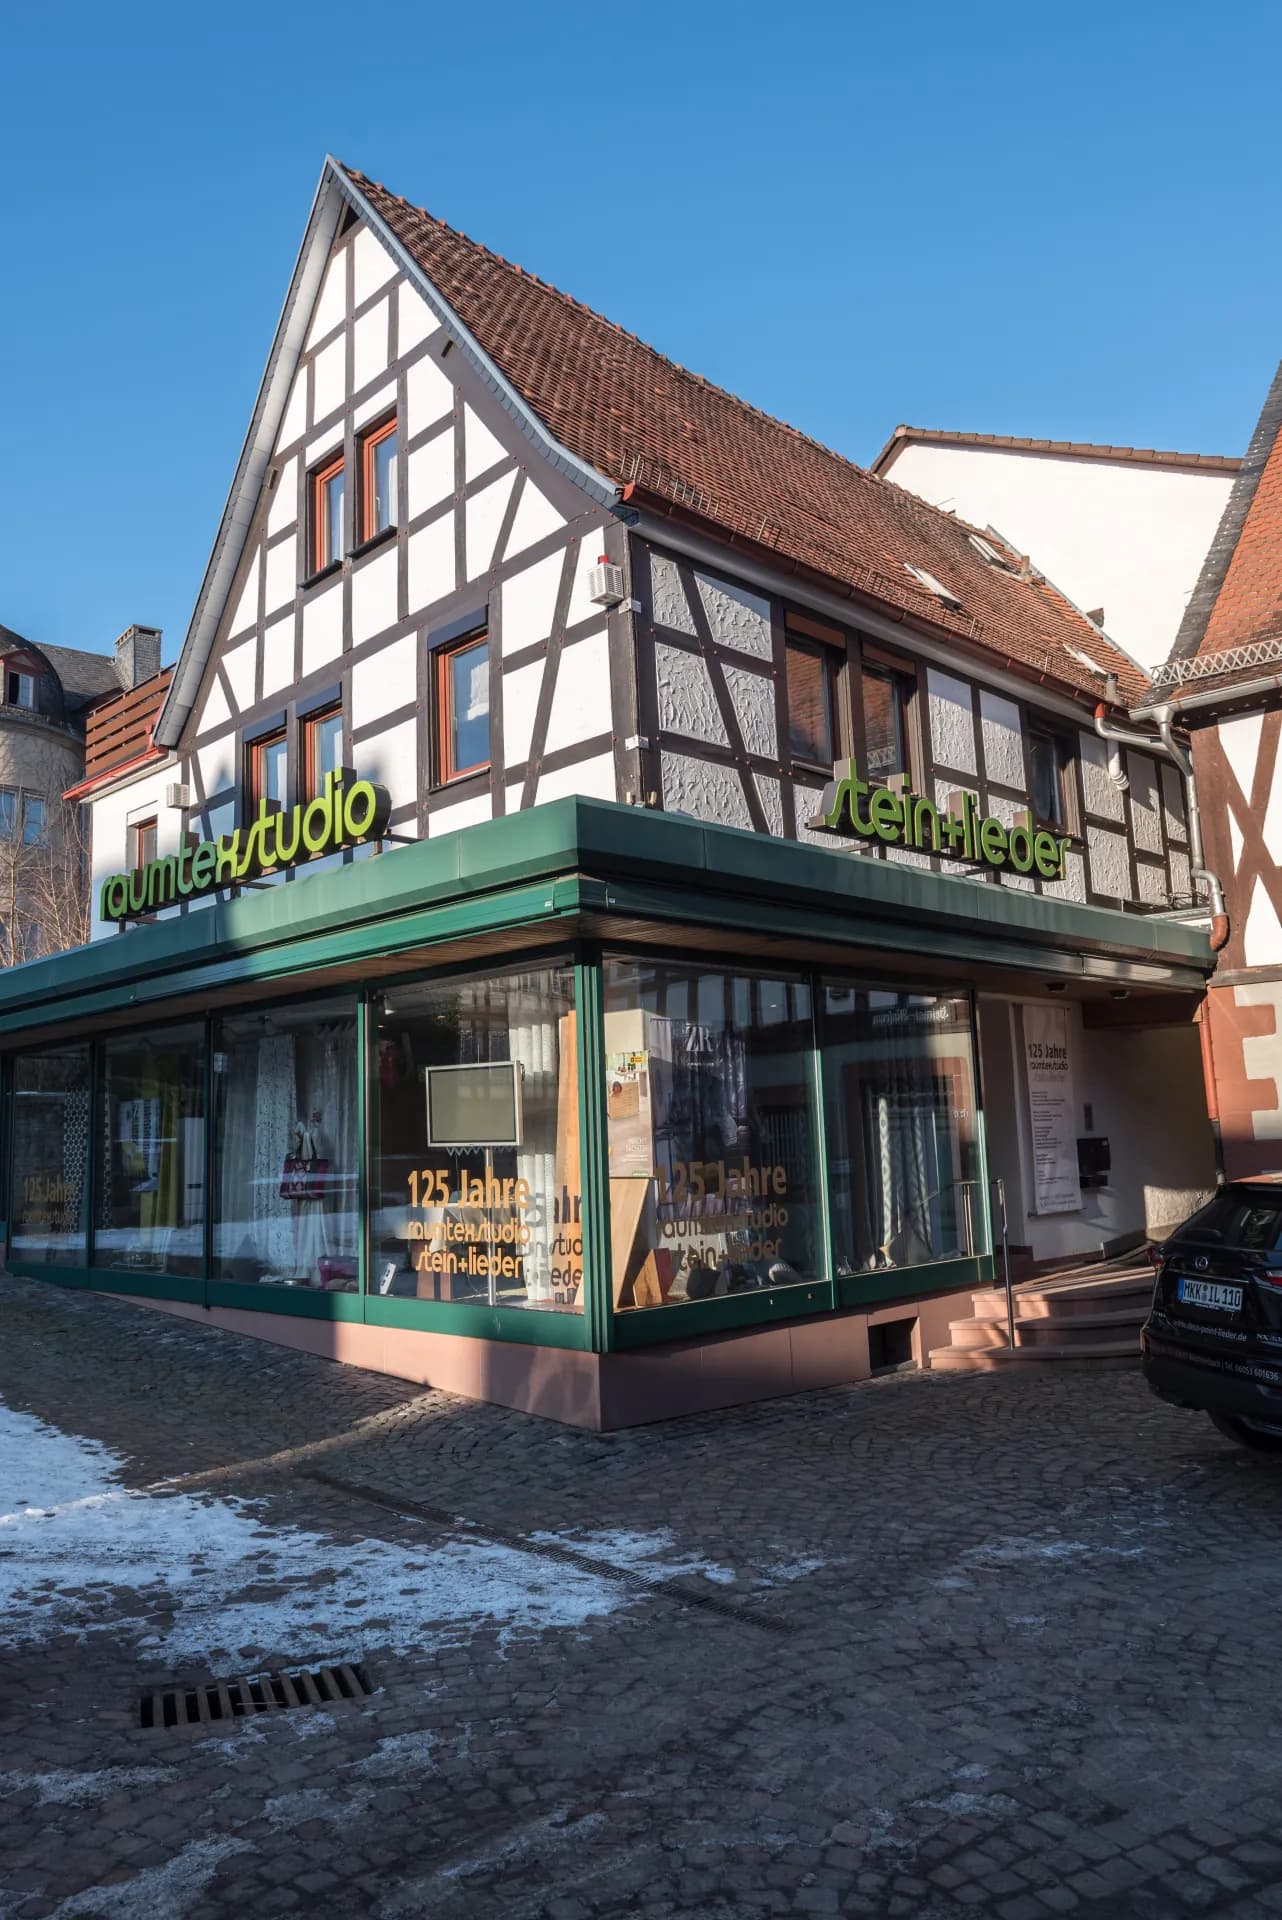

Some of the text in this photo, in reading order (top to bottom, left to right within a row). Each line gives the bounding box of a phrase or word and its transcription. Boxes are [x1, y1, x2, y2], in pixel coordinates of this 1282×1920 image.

[822, 757, 1072, 880] stein+lieder
[100, 766, 379, 921] raumtexstudio
[1028, 1042, 1067, 1059] 125 Jahre
[408, 1166, 530, 1208] 125 Jahre
[655, 1155, 787, 1205] 125 Jahre
[407, 1216, 531, 1244] raumtexstudio
[415, 1245, 522, 1278] stein+lieder
[1184, 1281, 1202, 1301] MKK
[1209, 1286, 1220, 1304] IL
[1222, 1288, 1241, 1308] 110
